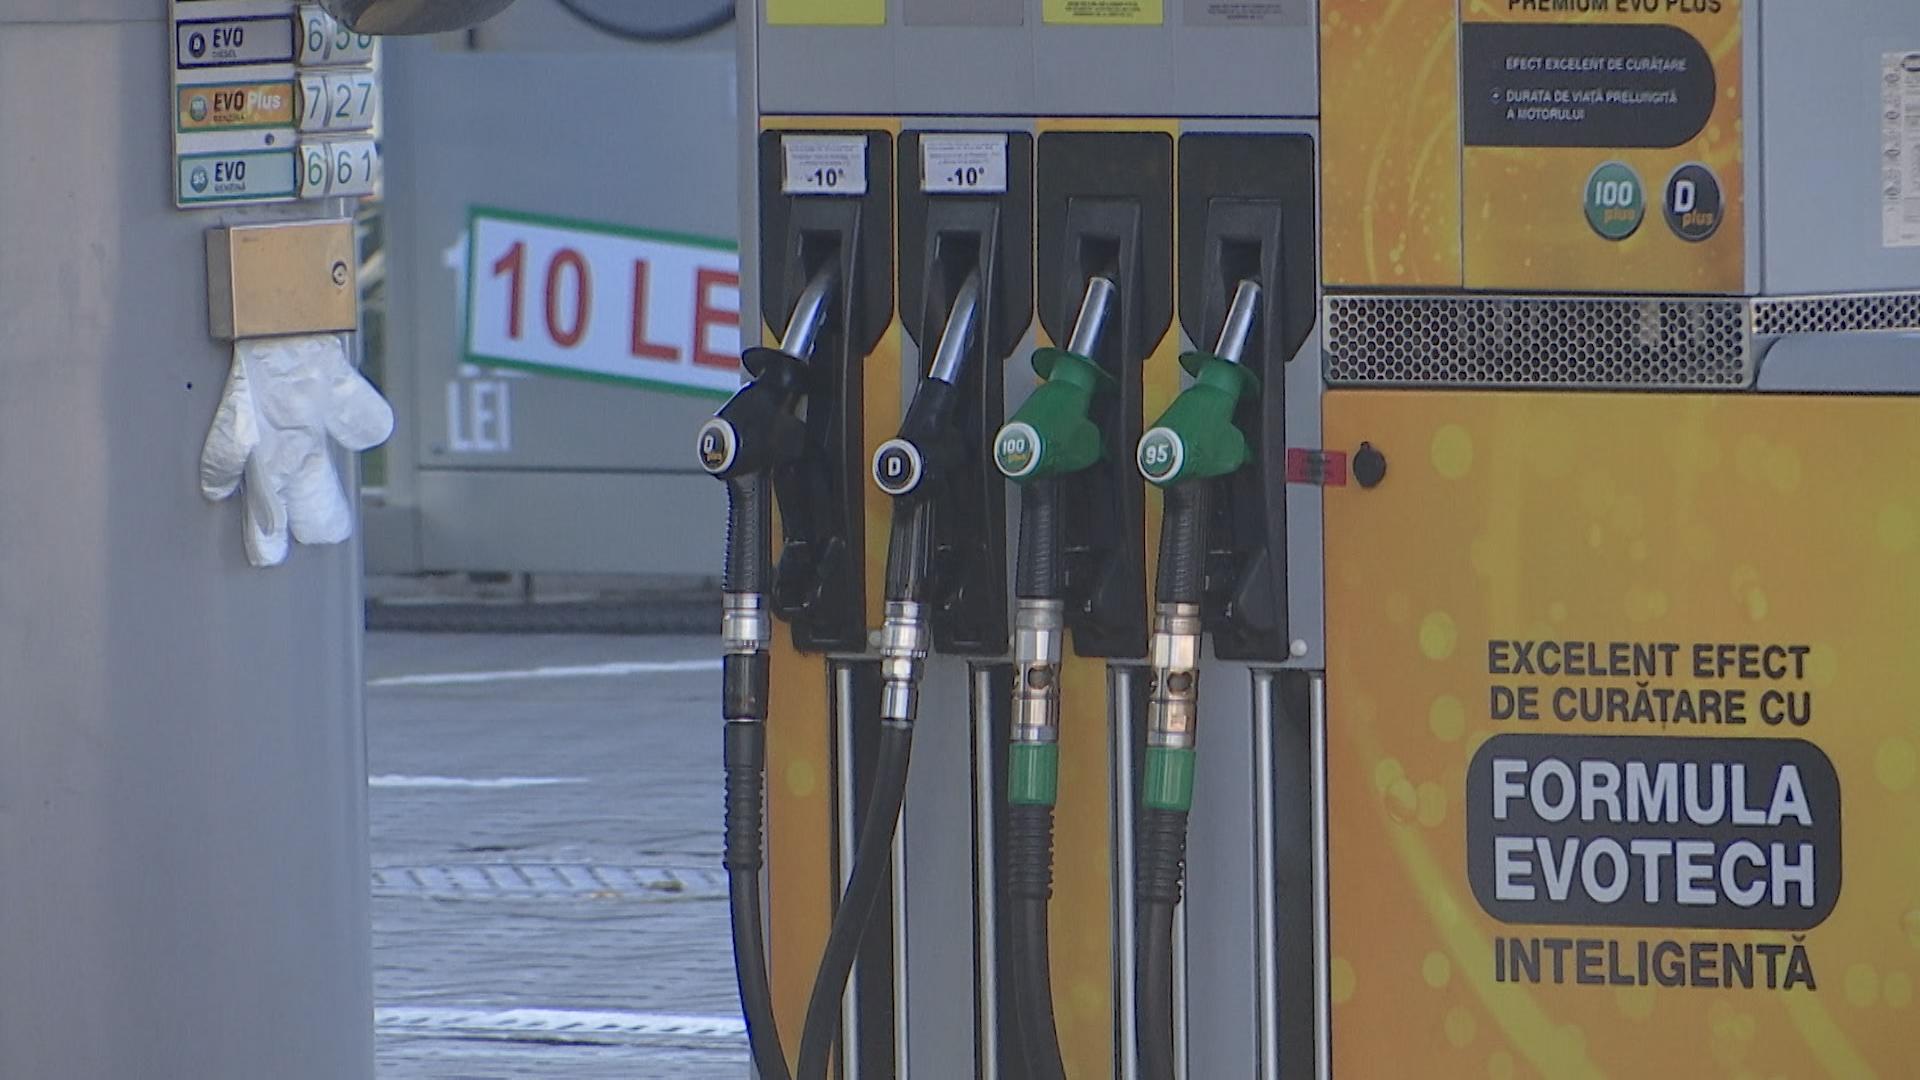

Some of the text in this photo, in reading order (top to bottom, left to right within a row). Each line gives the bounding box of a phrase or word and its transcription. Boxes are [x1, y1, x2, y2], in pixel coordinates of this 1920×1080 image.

[1508, 0, 1721, 14] PREMIUM EVO PLUS
[213, 27, 244, 48] EVO
[1505, 57, 1541, 71] EFECT
[1545, 57, 1604, 71] EXCELENT
[1608, 57, 1624, 71] DE
[213, 91, 244, 112] EVO
[248, 92, 281, 112] Plus
[1506, 89, 1550, 103] DURATA
[1554, 90, 1569, 103] DE
[1507, 108, 1585, 121] A MOTORULUI
[214, 161, 246, 182] EVO
[1595, 180, 1633, 207] 100
[1674, 180, 1695, 213] D
[1682, 210, 1713, 229] plus
[493, 239, 593, 349] 10
[448, 379, 512, 452] LEI
[1002, 439, 1026, 456] 100
[1145, 443, 1169, 465] 95
[887, 456, 902, 477] D
[1488, 640, 1811, 680] EXCELENT EFECT
[1490, 685, 1539, 721] DE
[1760, 690, 1812, 726] CU
[1492, 757, 1813, 827] FORMULA
[1494, 835, 1815, 909] EVOTECH
[1494, 933, 1817, 991] INTELIGENTĂ
